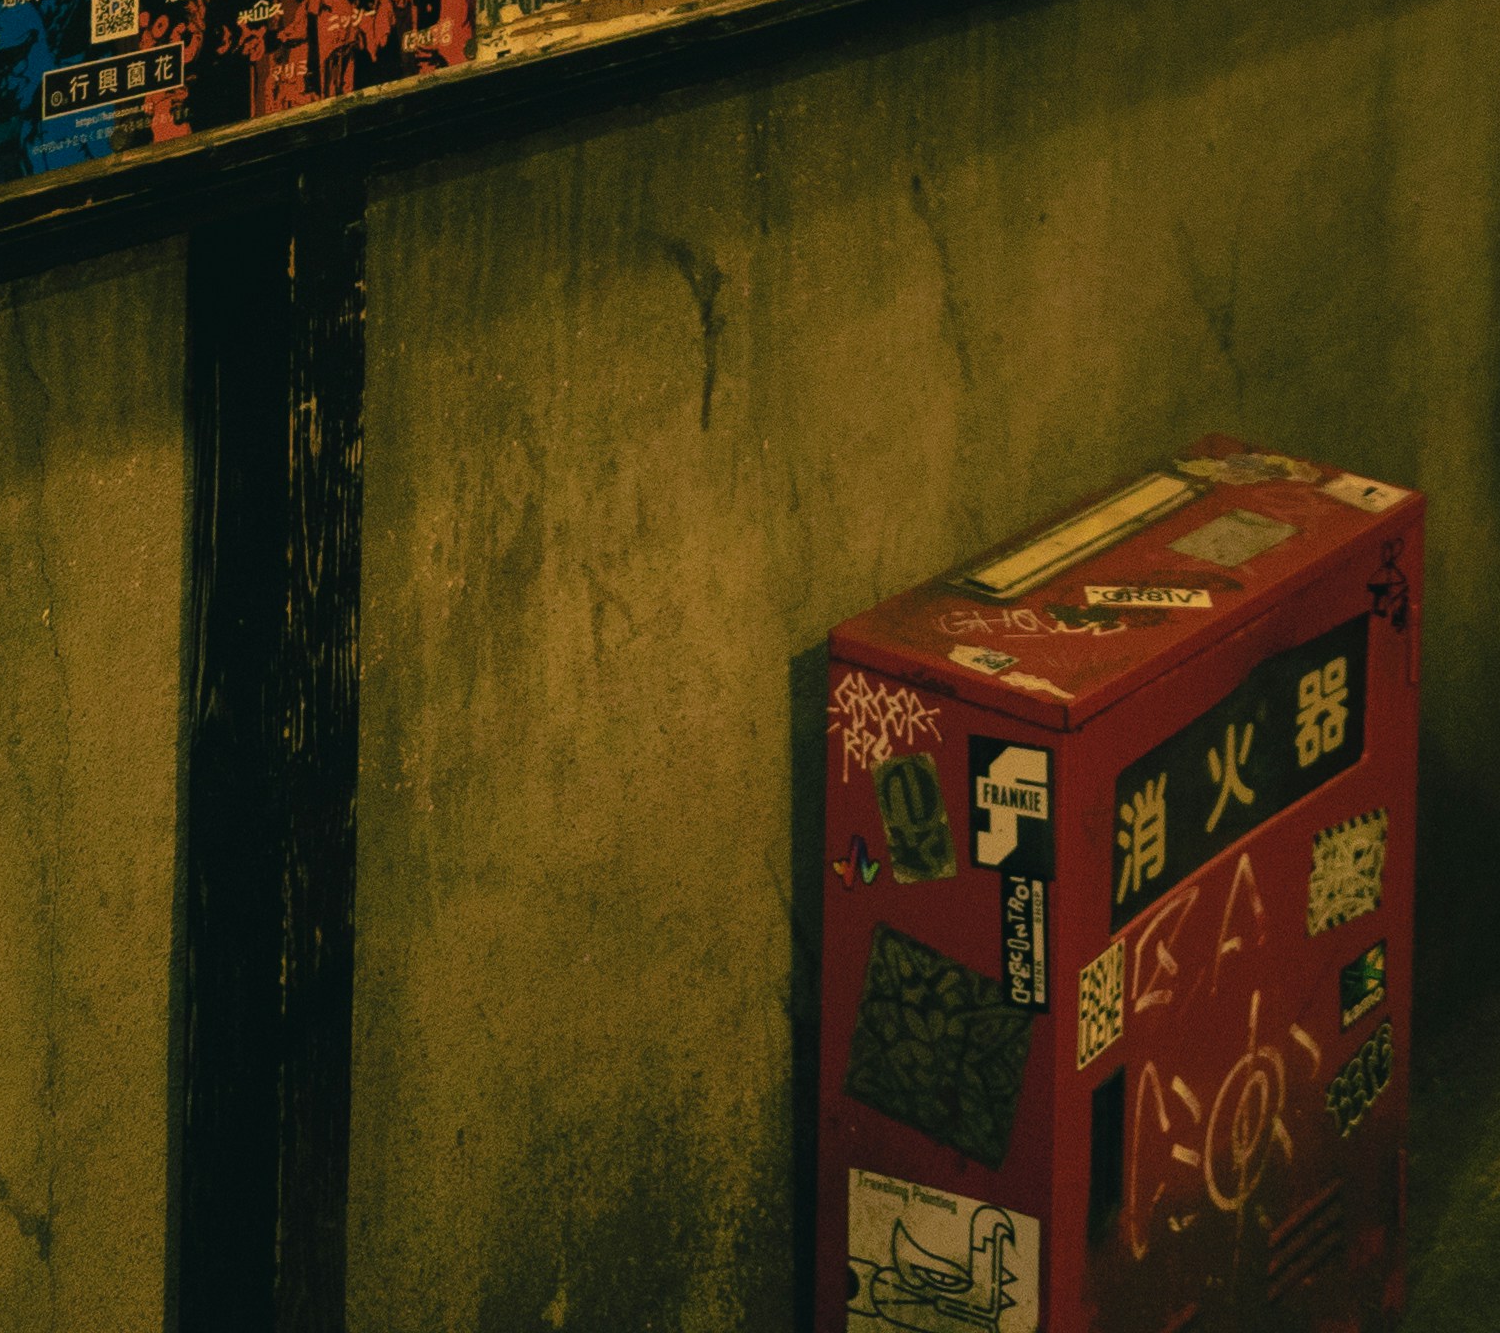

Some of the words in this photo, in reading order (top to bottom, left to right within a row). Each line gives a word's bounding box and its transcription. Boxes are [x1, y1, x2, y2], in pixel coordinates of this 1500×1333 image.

[982, 781, 1042, 813] FRANKIE
[1114, 656, 1349, 906] 消火器
[855, 1167, 910, 1203] Traveling
[911, 1183, 958, 1214] Painting
